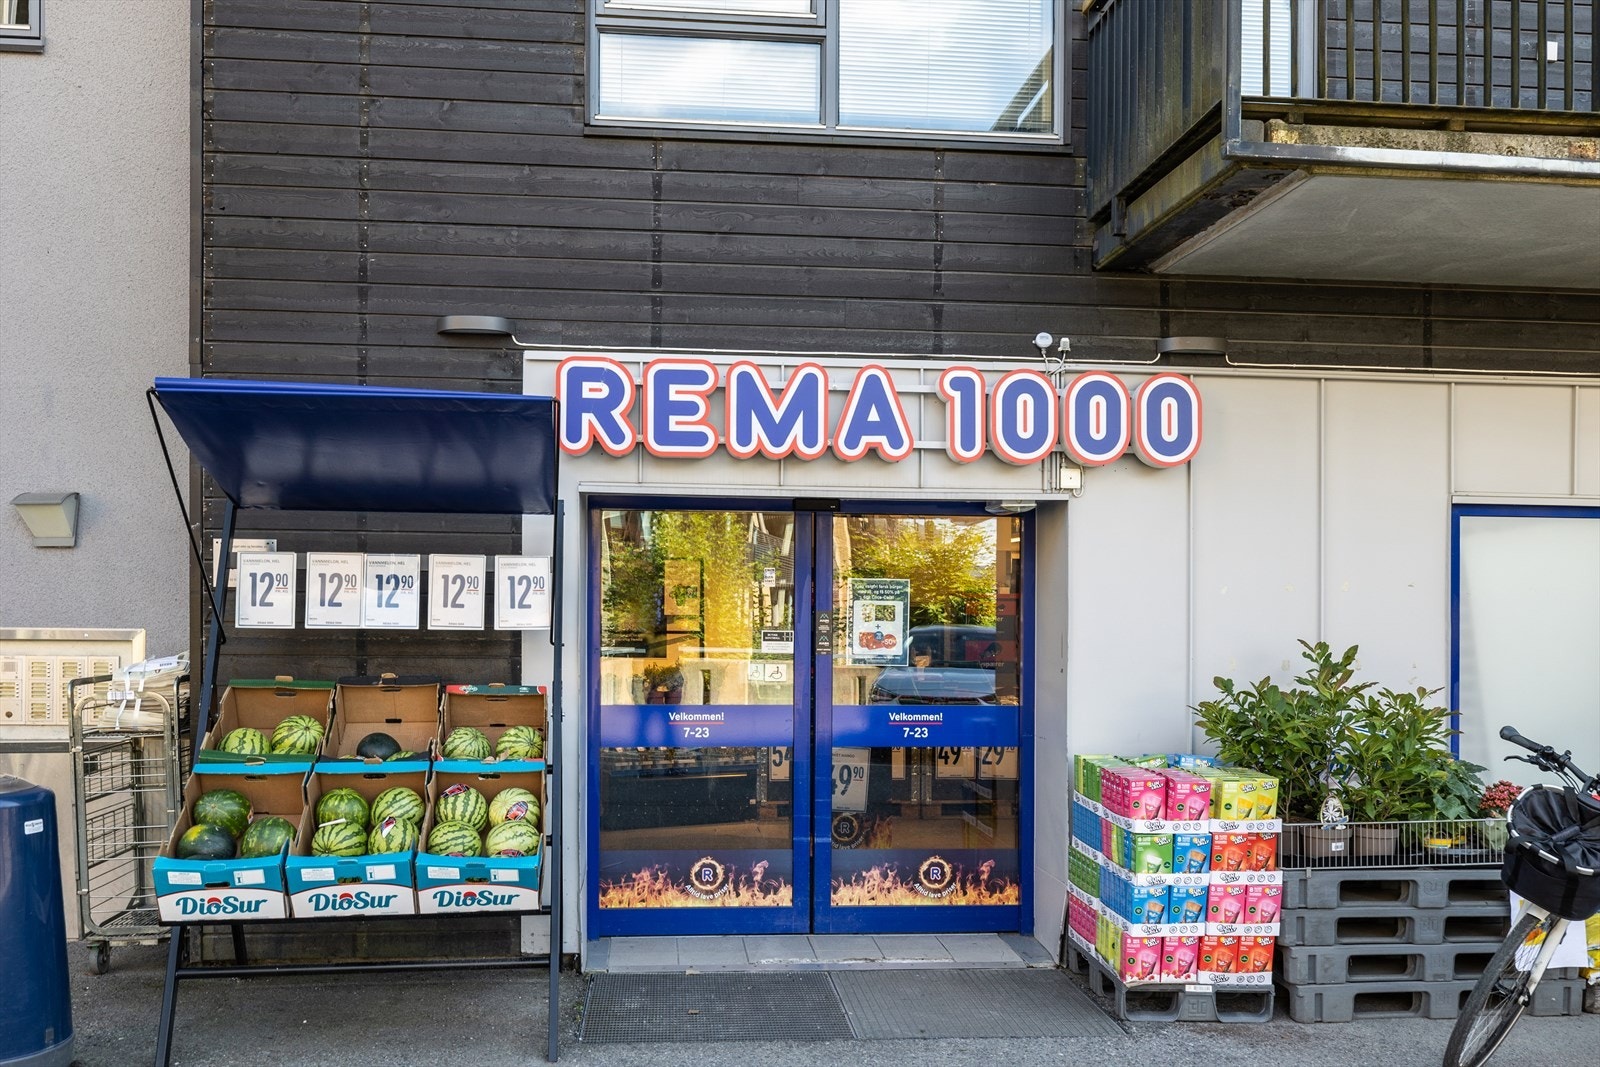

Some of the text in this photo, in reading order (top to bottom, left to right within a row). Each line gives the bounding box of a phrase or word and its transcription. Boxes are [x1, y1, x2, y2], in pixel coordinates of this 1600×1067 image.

[557, 357, 1202, 467] REMA 1000
[669, 712, 724, 720] Velkommen!
[889, 712, 943, 721] Velkommen!
[684, 727, 709, 738] 7-23
[903, 727, 928, 738] 7-23
[702, 868, 713, 881] R
[931, 867, 941, 880] R
[308, 891, 398, 911] DioSur
[433, 890, 520, 907] DioSur
[176, 896, 268, 915] DioSur
